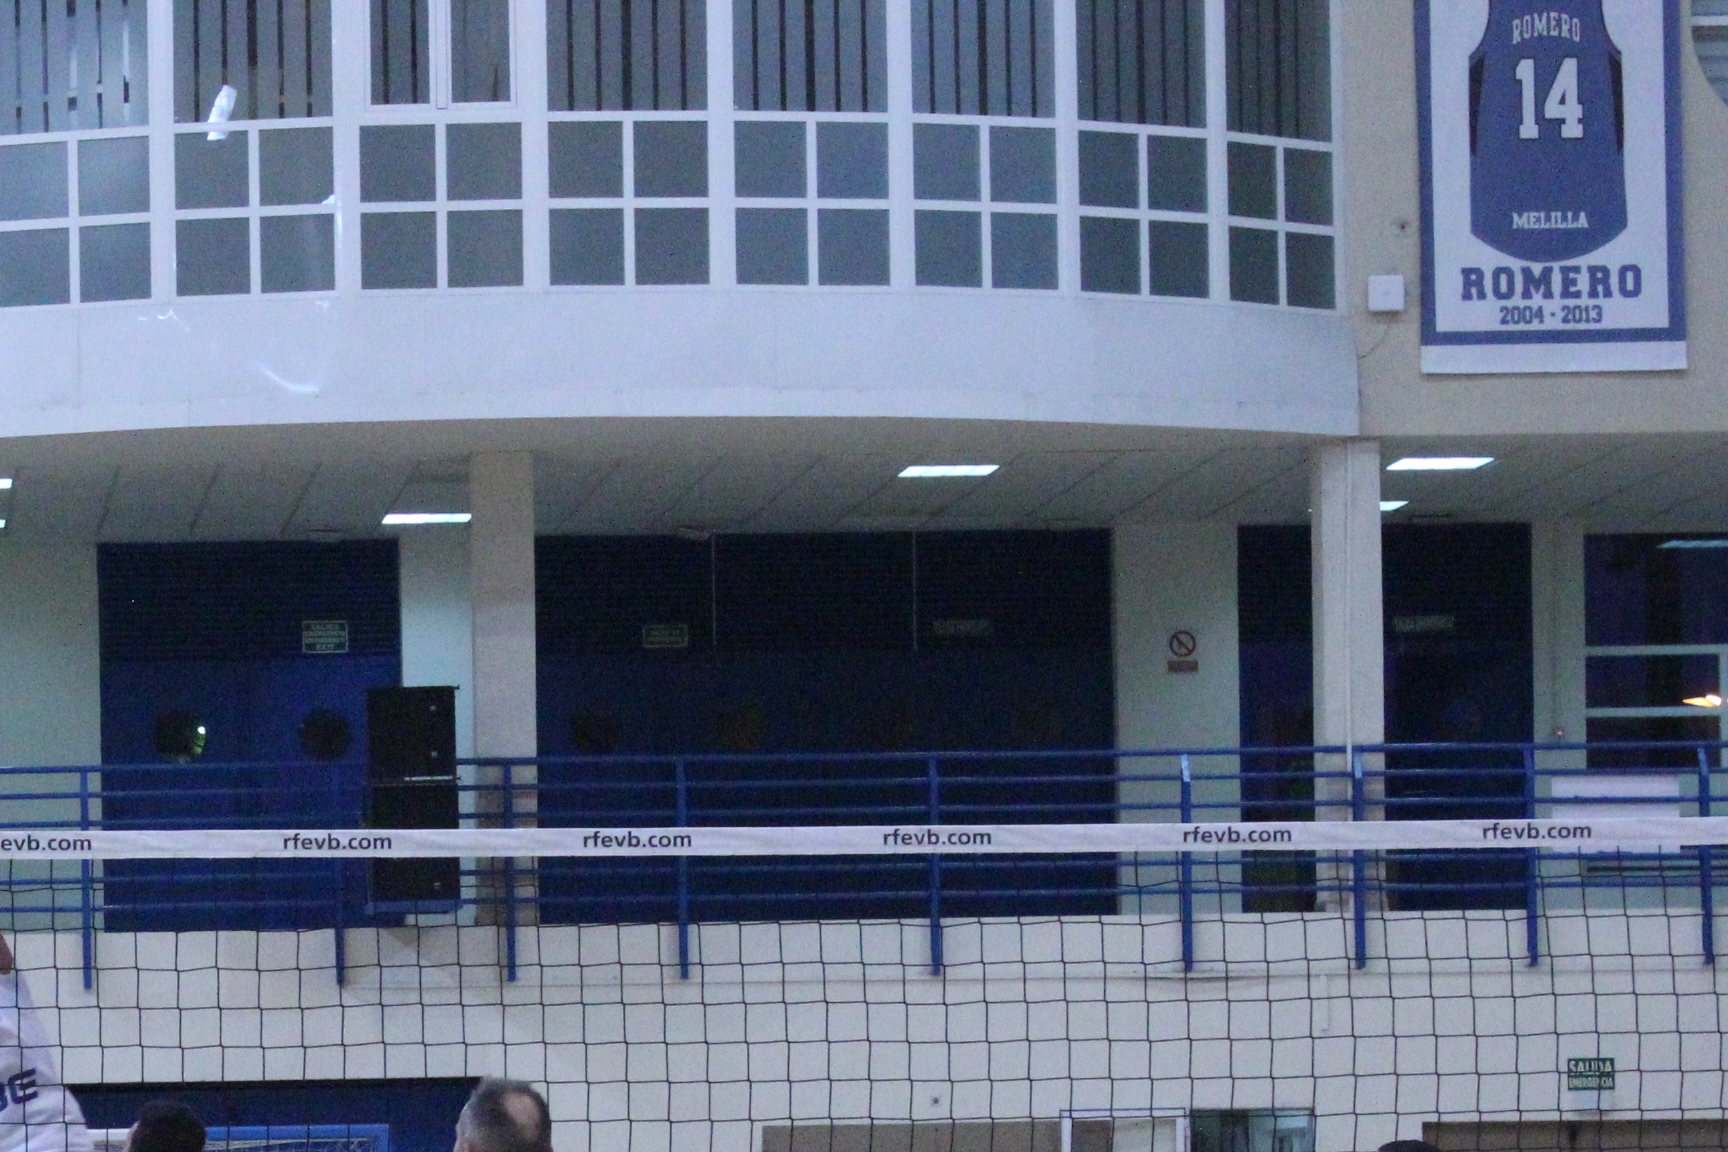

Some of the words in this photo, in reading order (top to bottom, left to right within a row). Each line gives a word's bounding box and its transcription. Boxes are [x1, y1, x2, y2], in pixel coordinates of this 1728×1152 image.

[1512, 11, 1581, 44] ROMERO
[1515, 57, 1584, 139] 14
[1512, 211, 1589, 229] MELILLA
[1460, 264, 1642, 301] ROMERO
[1499, 305, 1544, 325] 2004
[1561, 305, 1603, 324] 2013
[583, 831, 692, 848] rfevb.com
[883, 829, 992, 846] rfevb.com
[1183, 826, 1292, 843] rfevb.com
[1482, 823, 1592, 840] rfevb.com
[283, 833, 392, 850] rfevb.com
